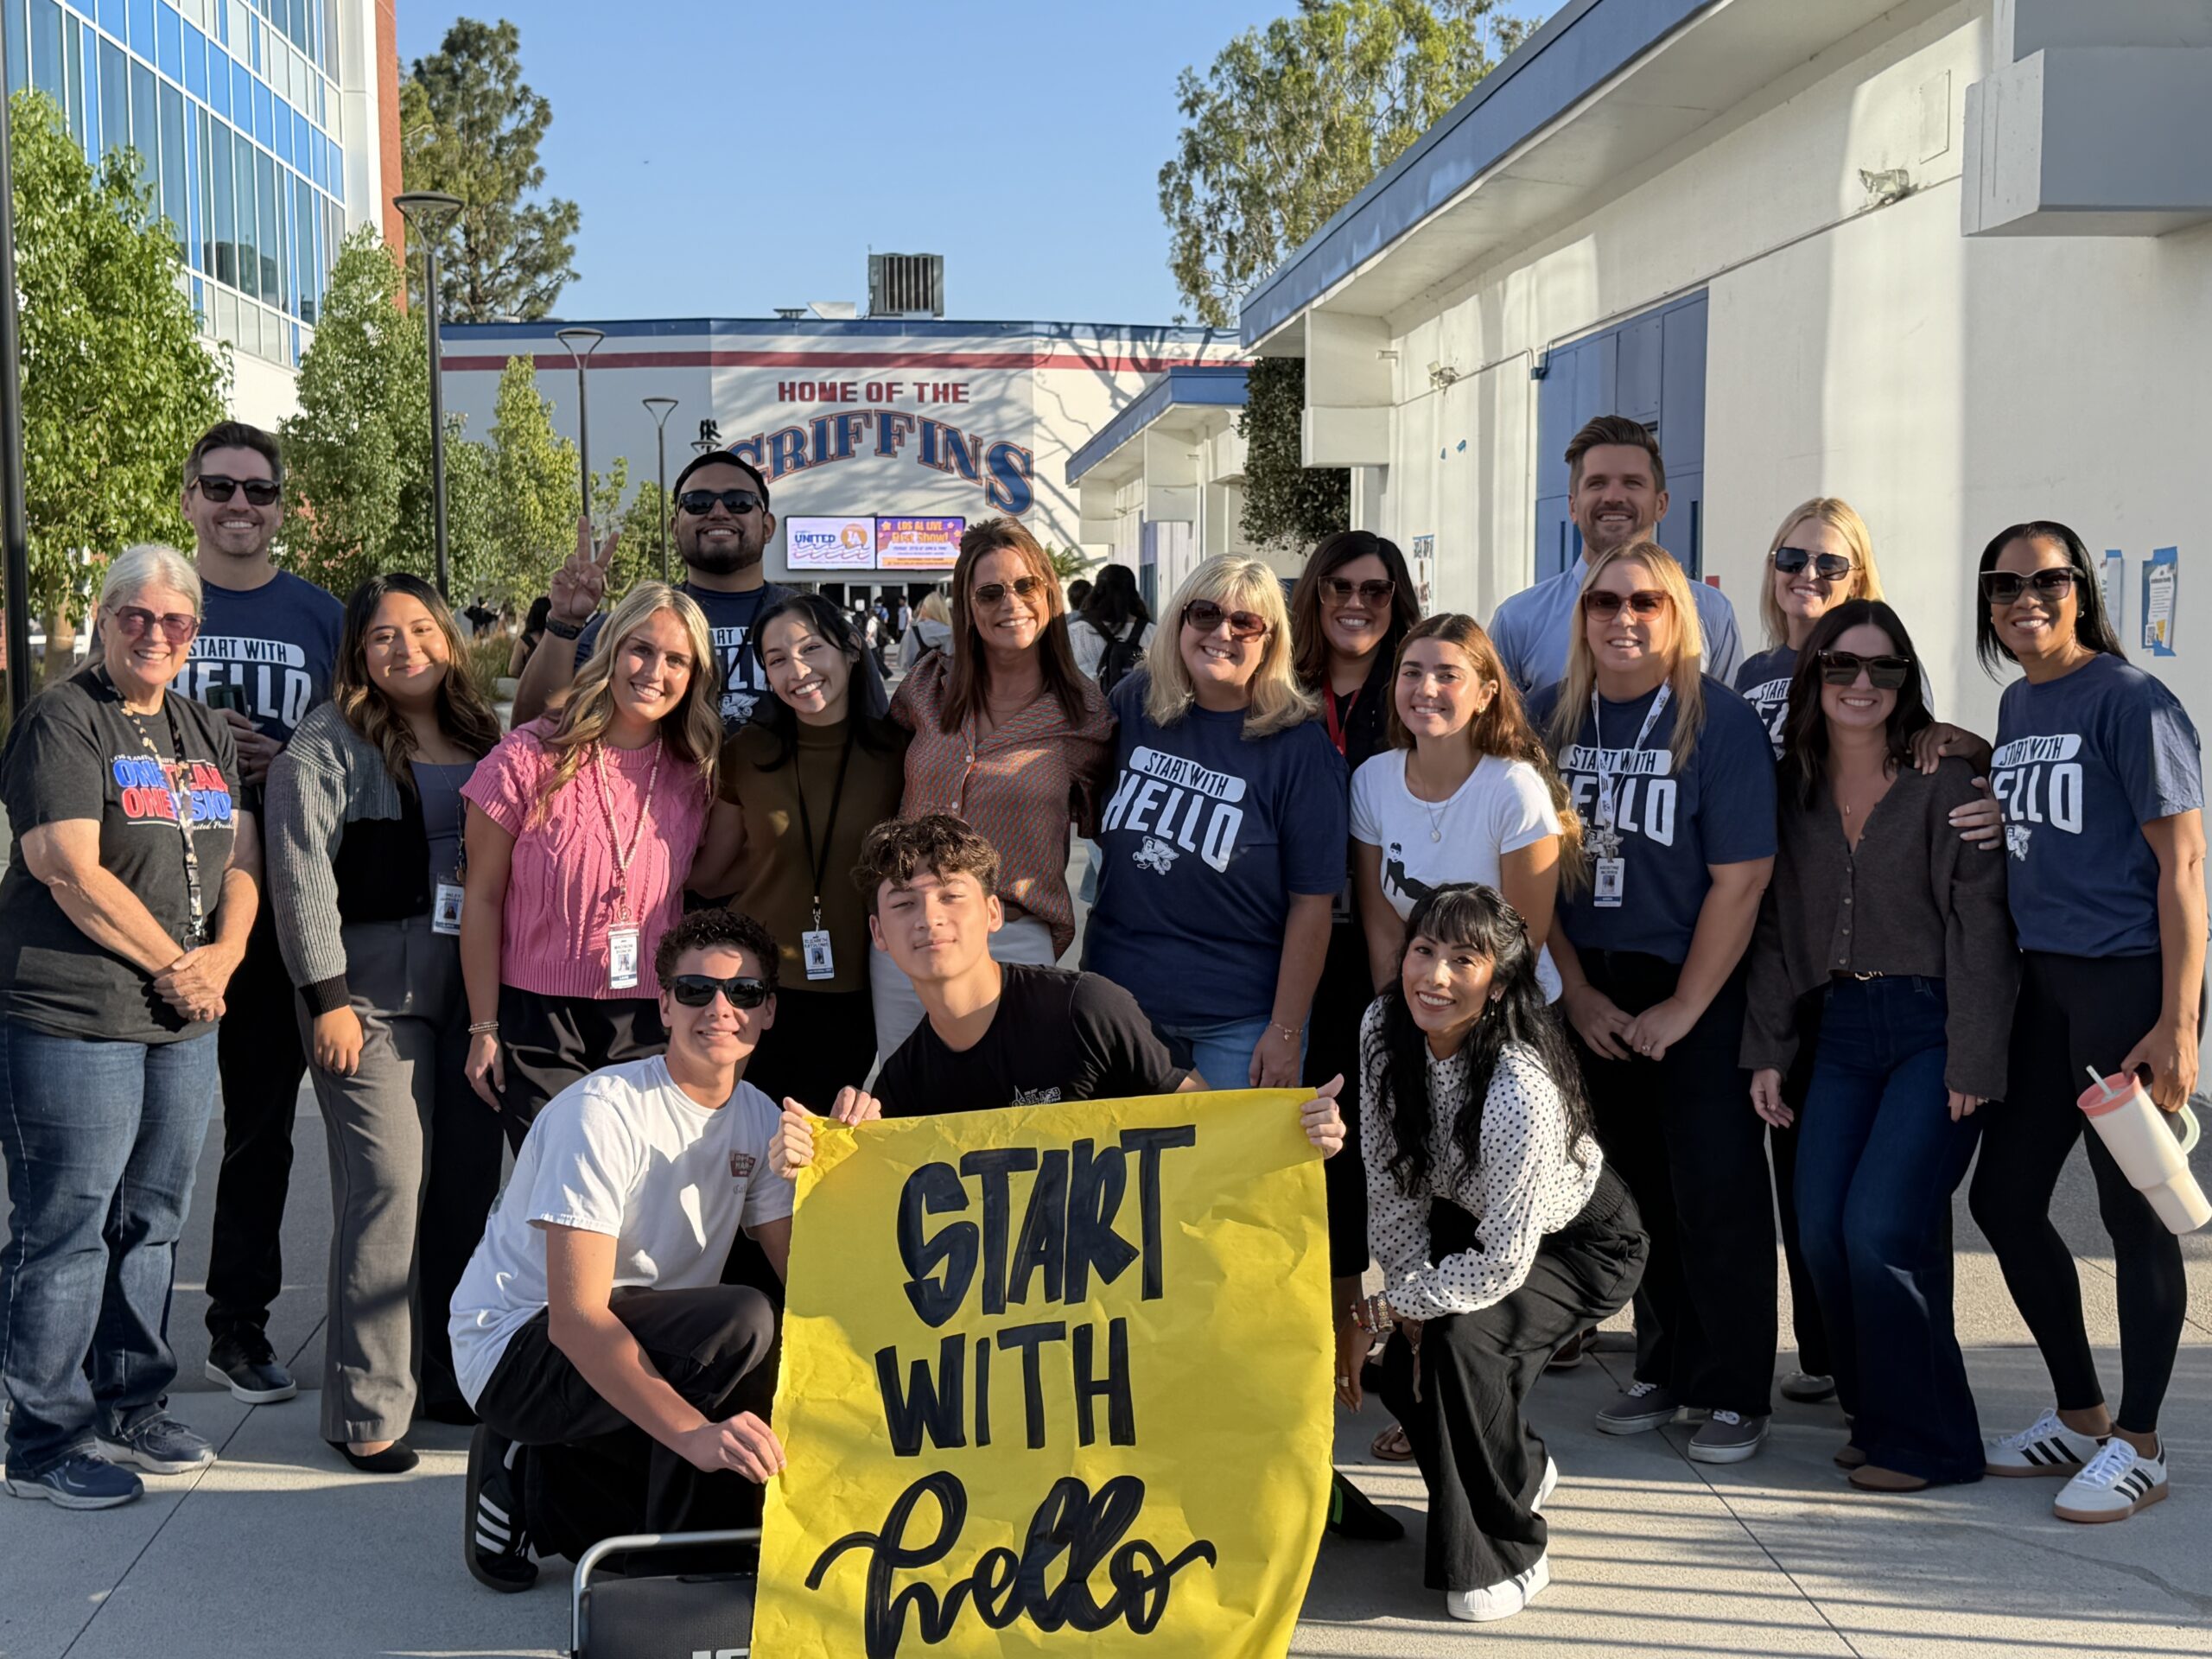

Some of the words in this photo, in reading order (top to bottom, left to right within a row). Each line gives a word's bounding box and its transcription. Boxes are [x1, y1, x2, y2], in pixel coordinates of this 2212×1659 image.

[778, 381, 858, 403] HOME
[865, 381, 904, 403] OF
[912, 381, 969, 404] THE
[725, 410, 1034, 516] GRIFFINS
[794, 534, 836, 543] UNITED
[188, 638, 237, 658] START
[244, 639, 288, 663] WITH
[1760, 679, 1790, 701] STAR
[1620, 750, 1656, 773] WITH
[1999, 740, 2029, 766] START
[2028, 736, 2064, 760] WITH
[112, 759, 168, 789] ONE
[162, 763, 229, 793] TAM
[1143, 752, 1188, 783] START
[1190, 763, 1230, 798] WITH
[122, 786, 173, 819] ONE
[1558, 773, 1677, 847] ELO
[1988, 765, 2082, 834] ELLO
[1100, 769, 1244, 874] HELLO
[896, 1124, 1197, 1329] START
[874, 1317, 1137, 1457] WITH
[804, 1471, 1217, 1659] hello
